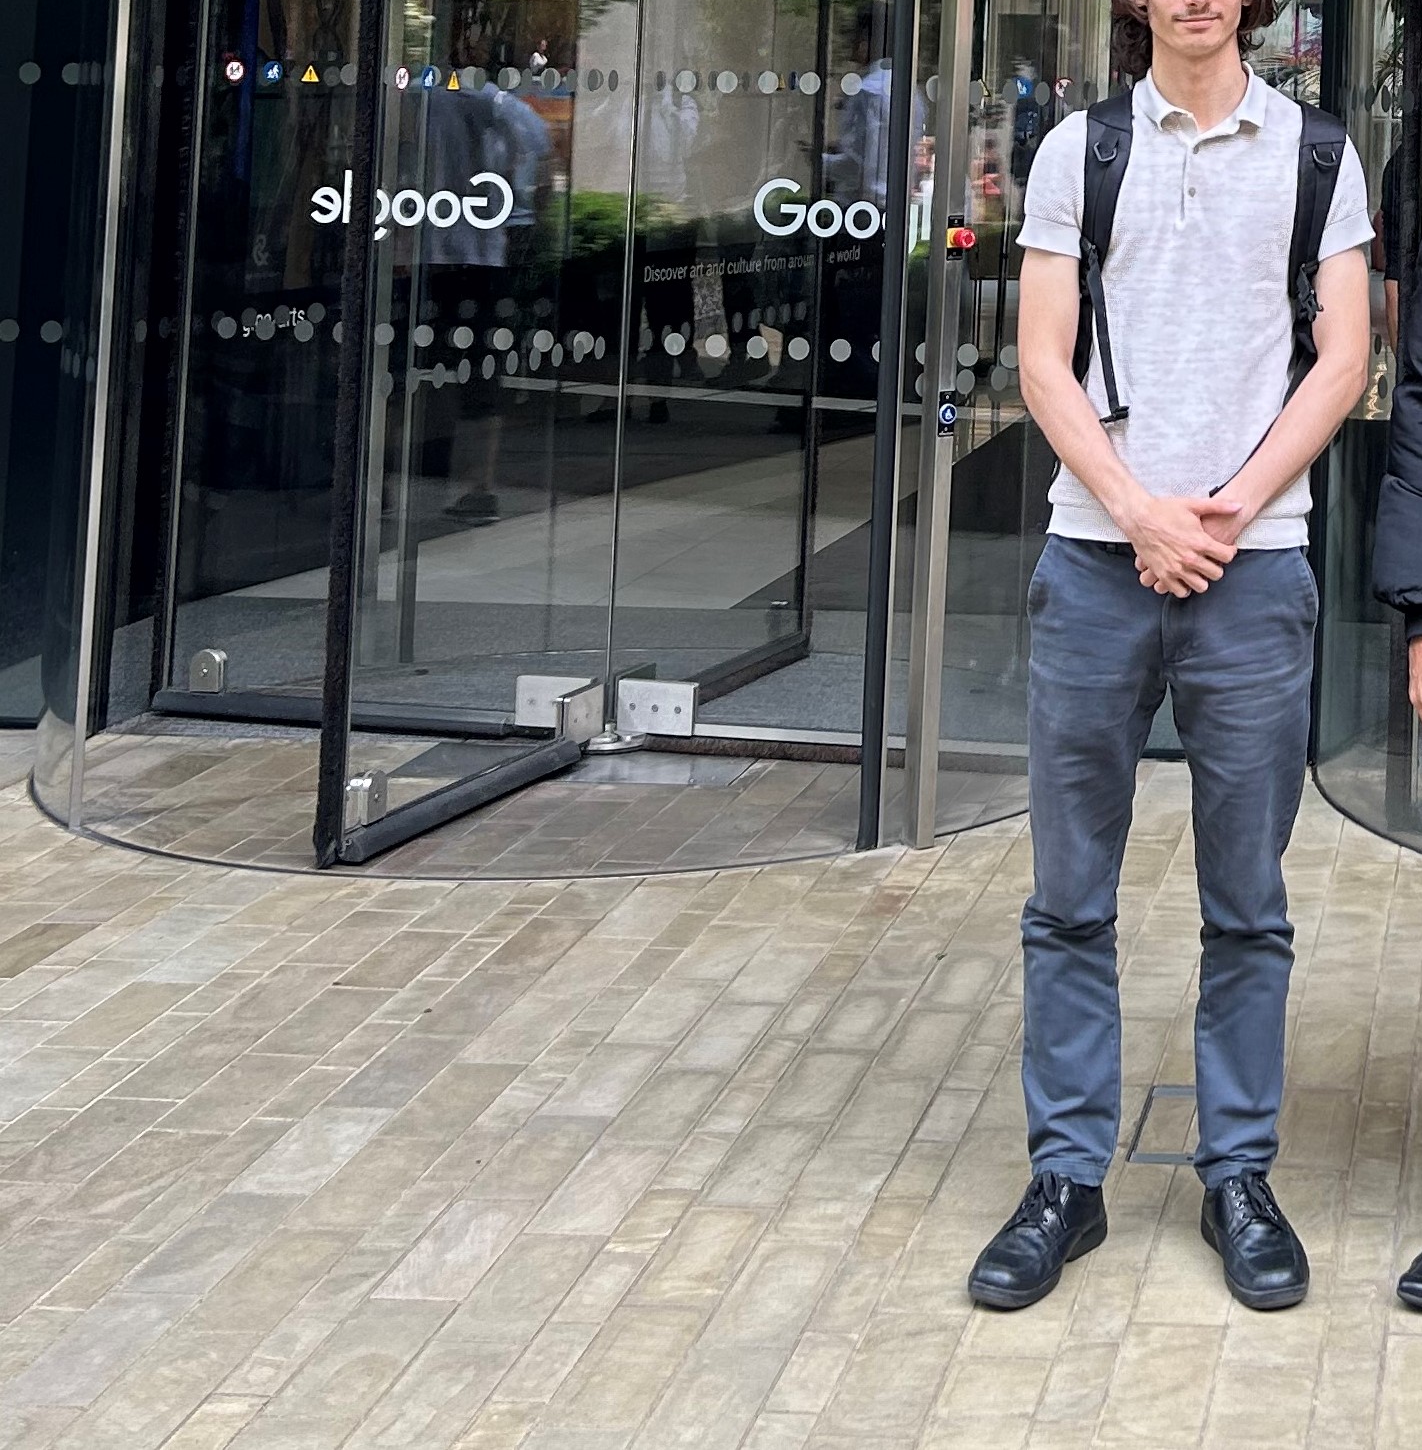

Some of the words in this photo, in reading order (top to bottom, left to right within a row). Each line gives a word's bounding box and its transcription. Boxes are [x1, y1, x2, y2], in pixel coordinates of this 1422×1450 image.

[643, 263, 688, 283] Discover
[689, 261, 705, 279] art
[705, 257, 727, 277] and
[727, 256, 762, 275] culture
[763, 254, 787, 271] from
[787, 254, 815, 269] aroun
[836, 244, 862, 263] world
